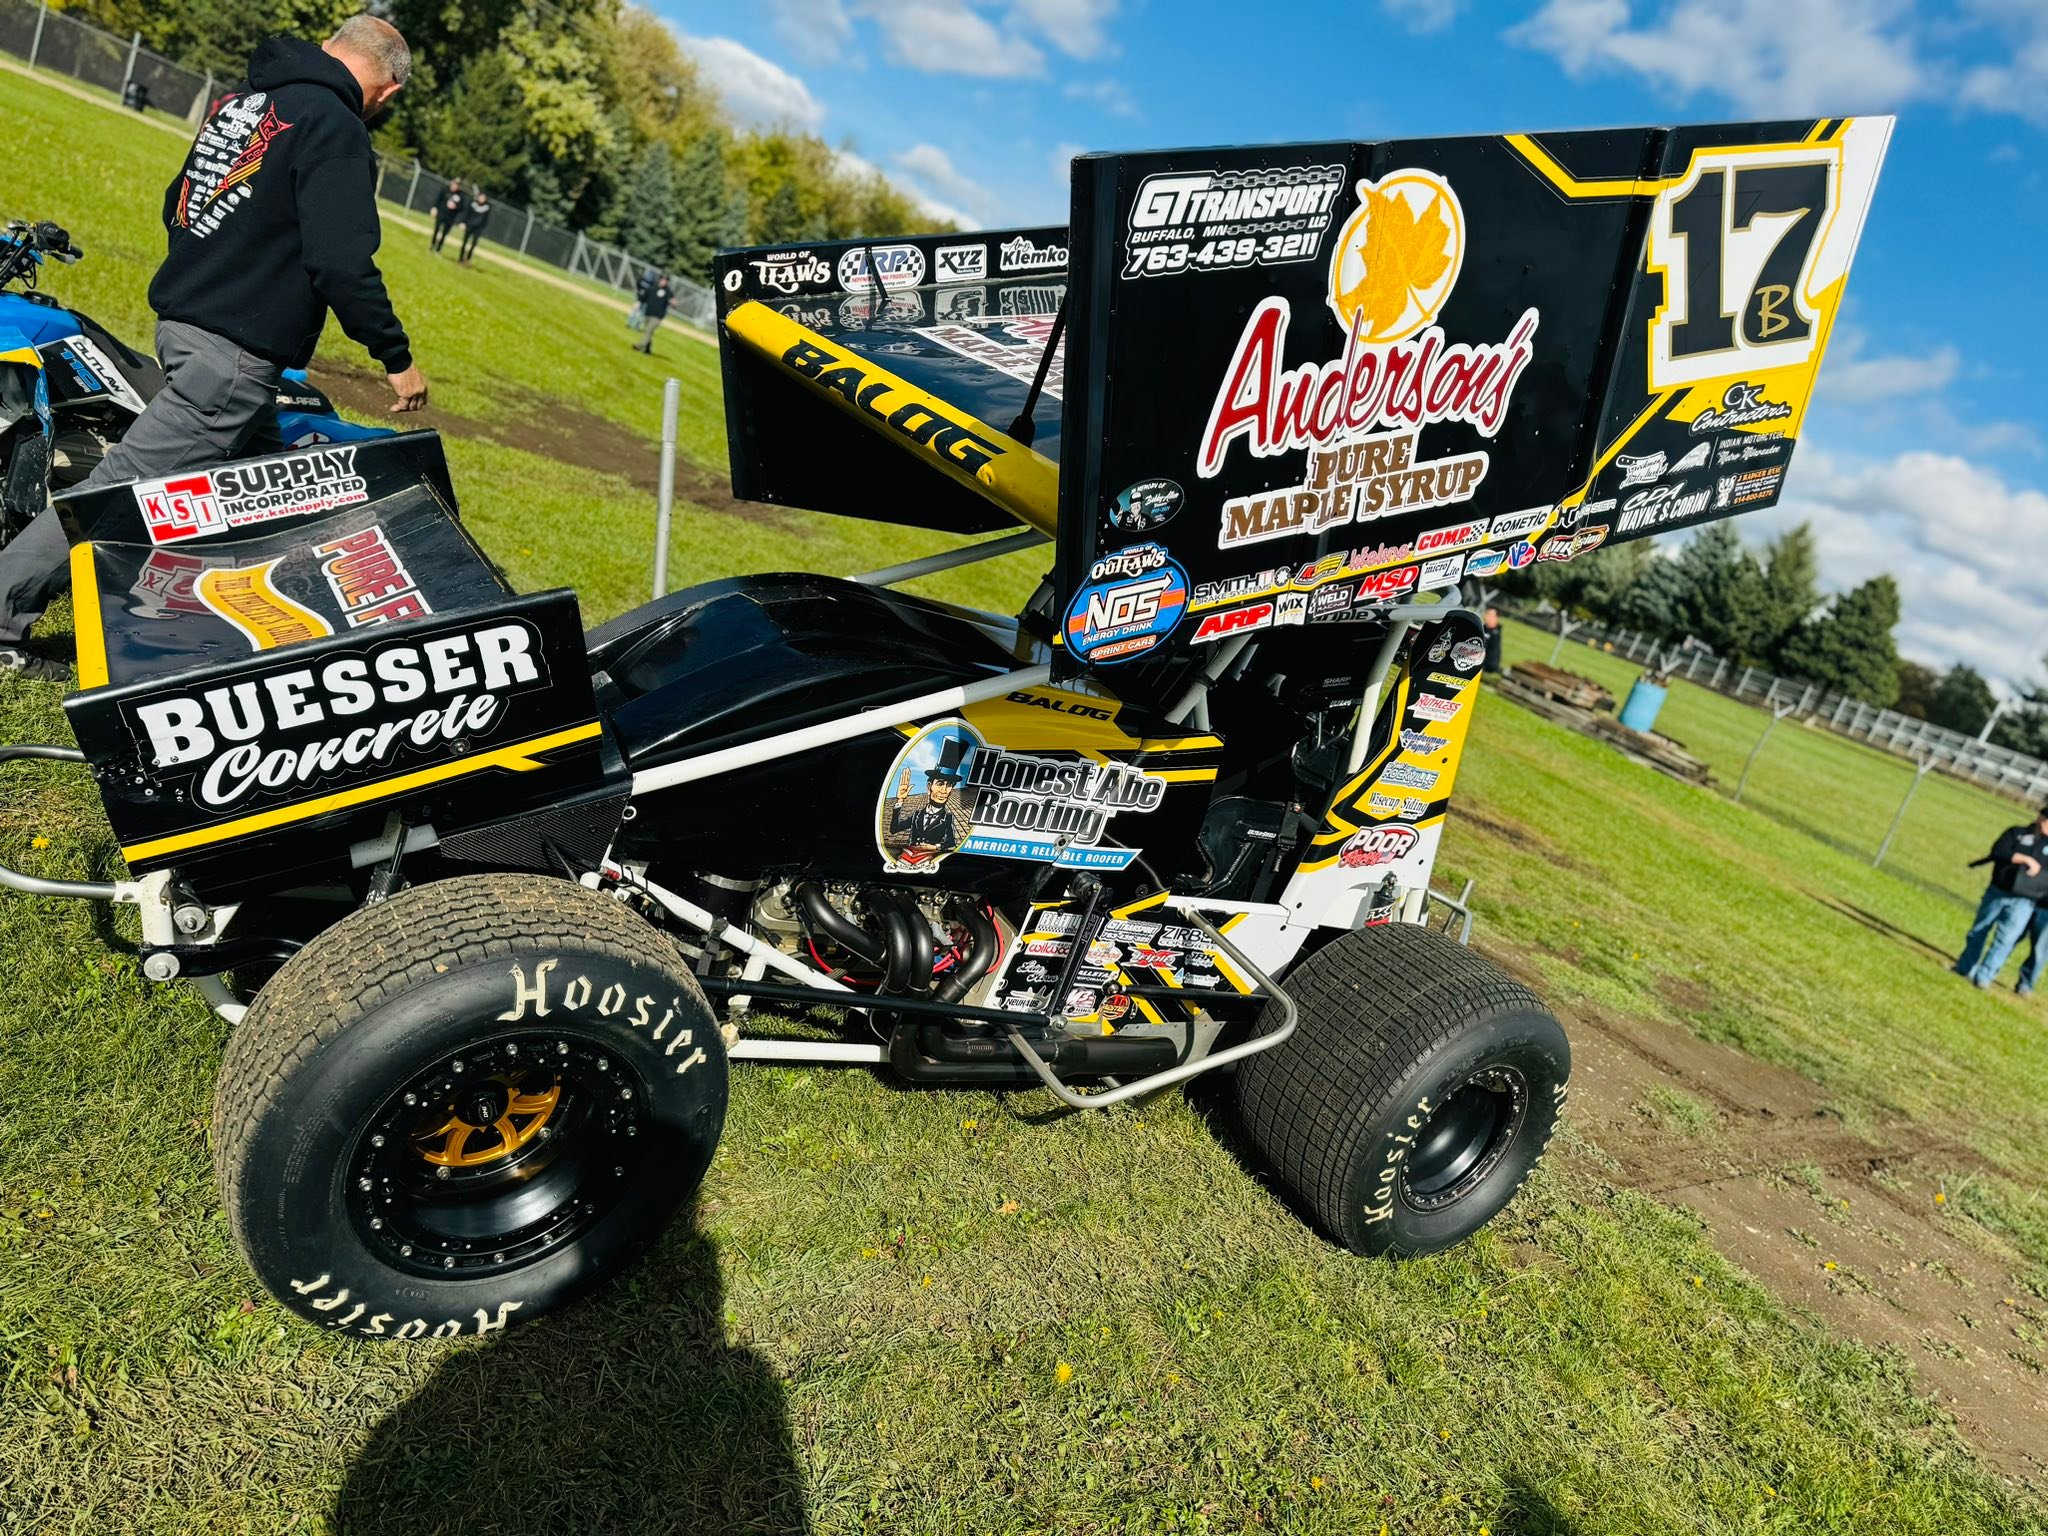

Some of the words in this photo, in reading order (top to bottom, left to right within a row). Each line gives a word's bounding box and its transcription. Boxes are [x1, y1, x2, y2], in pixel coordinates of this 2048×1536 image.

[1132, 176, 1212, 229] GT
[1188, 182, 1339, 223] TRANSPORT
[1130, 227, 1196, 245] BUFFALO,
[1202, 226, 1229, 237] MN
[1308, 214, 1328, 229] LLC
[766, 252, 797, 262] WORLD
[798, 250, 811, 259] OF
[938, 249, 983, 273] XYZ
[1002, 247, 1068, 267] Klemko
[1129, 231, 1319, 274] 763-439-3211
[1667, 160, 1834, 361] 17
[1756, 283, 1791, 339] B
[60, 347, 102, 391] 110
[73, 340, 125, 393] OUTLAW
[1204, 306, 1534, 468] Anderson's
[1724, 384, 1763, 411] CK
[781, 338, 1006, 474] BALOG
[1690, 403, 1791, 432] Contractors
[1718, 437, 1743, 450] INDIAN
[215, 450, 355, 498] SUPPLY
[1311, 433, 1414, 490] PURE
[146, 496, 213, 524] KSI
[223, 478, 365, 516] INCORPORATED
[230, 491, 367, 526] www.ksisupply.com
[1224, 486, 1352, 541] MAPLE
[1363, 458, 1484, 515] SYRUP
[1616, 503, 1662, 533] WAYNE
[1669, 489, 1712, 519] CORINI
[1623, 482, 1686, 512] CPA
[1492, 510, 1548, 534] COMETIC
[1123, 547, 1144, 556] WORLD
[1417, 525, 1472, 552] COMP
[1453, 535, 1479, 546] CAMS
[320, 528, 409, 607] PURE
[1091, 548, 1167, 580] OUTLAWS
[1510, 541, 1531, 568] VP
[1194, 592, 1228, 606] BRAKE
[1227, 583, 1272, 598] SYSTEMS
[1357, 565, 1420, 599] MSD
[1082, 571, 1175, 637] NOS
[1278, 597, 1304, 614] WIX
[1317, 589, 1349, 607] WELD
[1082, 627, 1122, 647] ENERGY
[1122, 621, 1154, 635] DRINK
[1194, 604, 1273, 638] ARP
[1090, 644, 1126, 659] SPRINT
[1127, 636, 1156, 651] CARS
[138, 624, 539, 768] BUESSER
[1004, 690, 1114, 721] BALOG
[1416, 694, 1461, 712] RUTHLESS
[200, 692, 499, 805] Concrete
[1406, 740, 1434, 755] Family
[967, 746, 1097, 798] Honest
[1097, 761, 1166, 808] Abe
[1382, 767, 1438, 784] ROCKVILLE
[969, 787, 1108, 845] Roofing
[1368, 792, 1400, 811] Wisecup
[1400, 796, 1428, 814] Siding
[964, 838, 1028, 855] AMERICA'S
[1030, 844, 1082, 862] RELIABLE
[1084, 850, 1125, 865] ROOFER
[1347, 828, 1416, 857] POOR
[496, 957, 707, 1074] Hoosier
[1363, 1095, 1434, 1227] Hoosier
